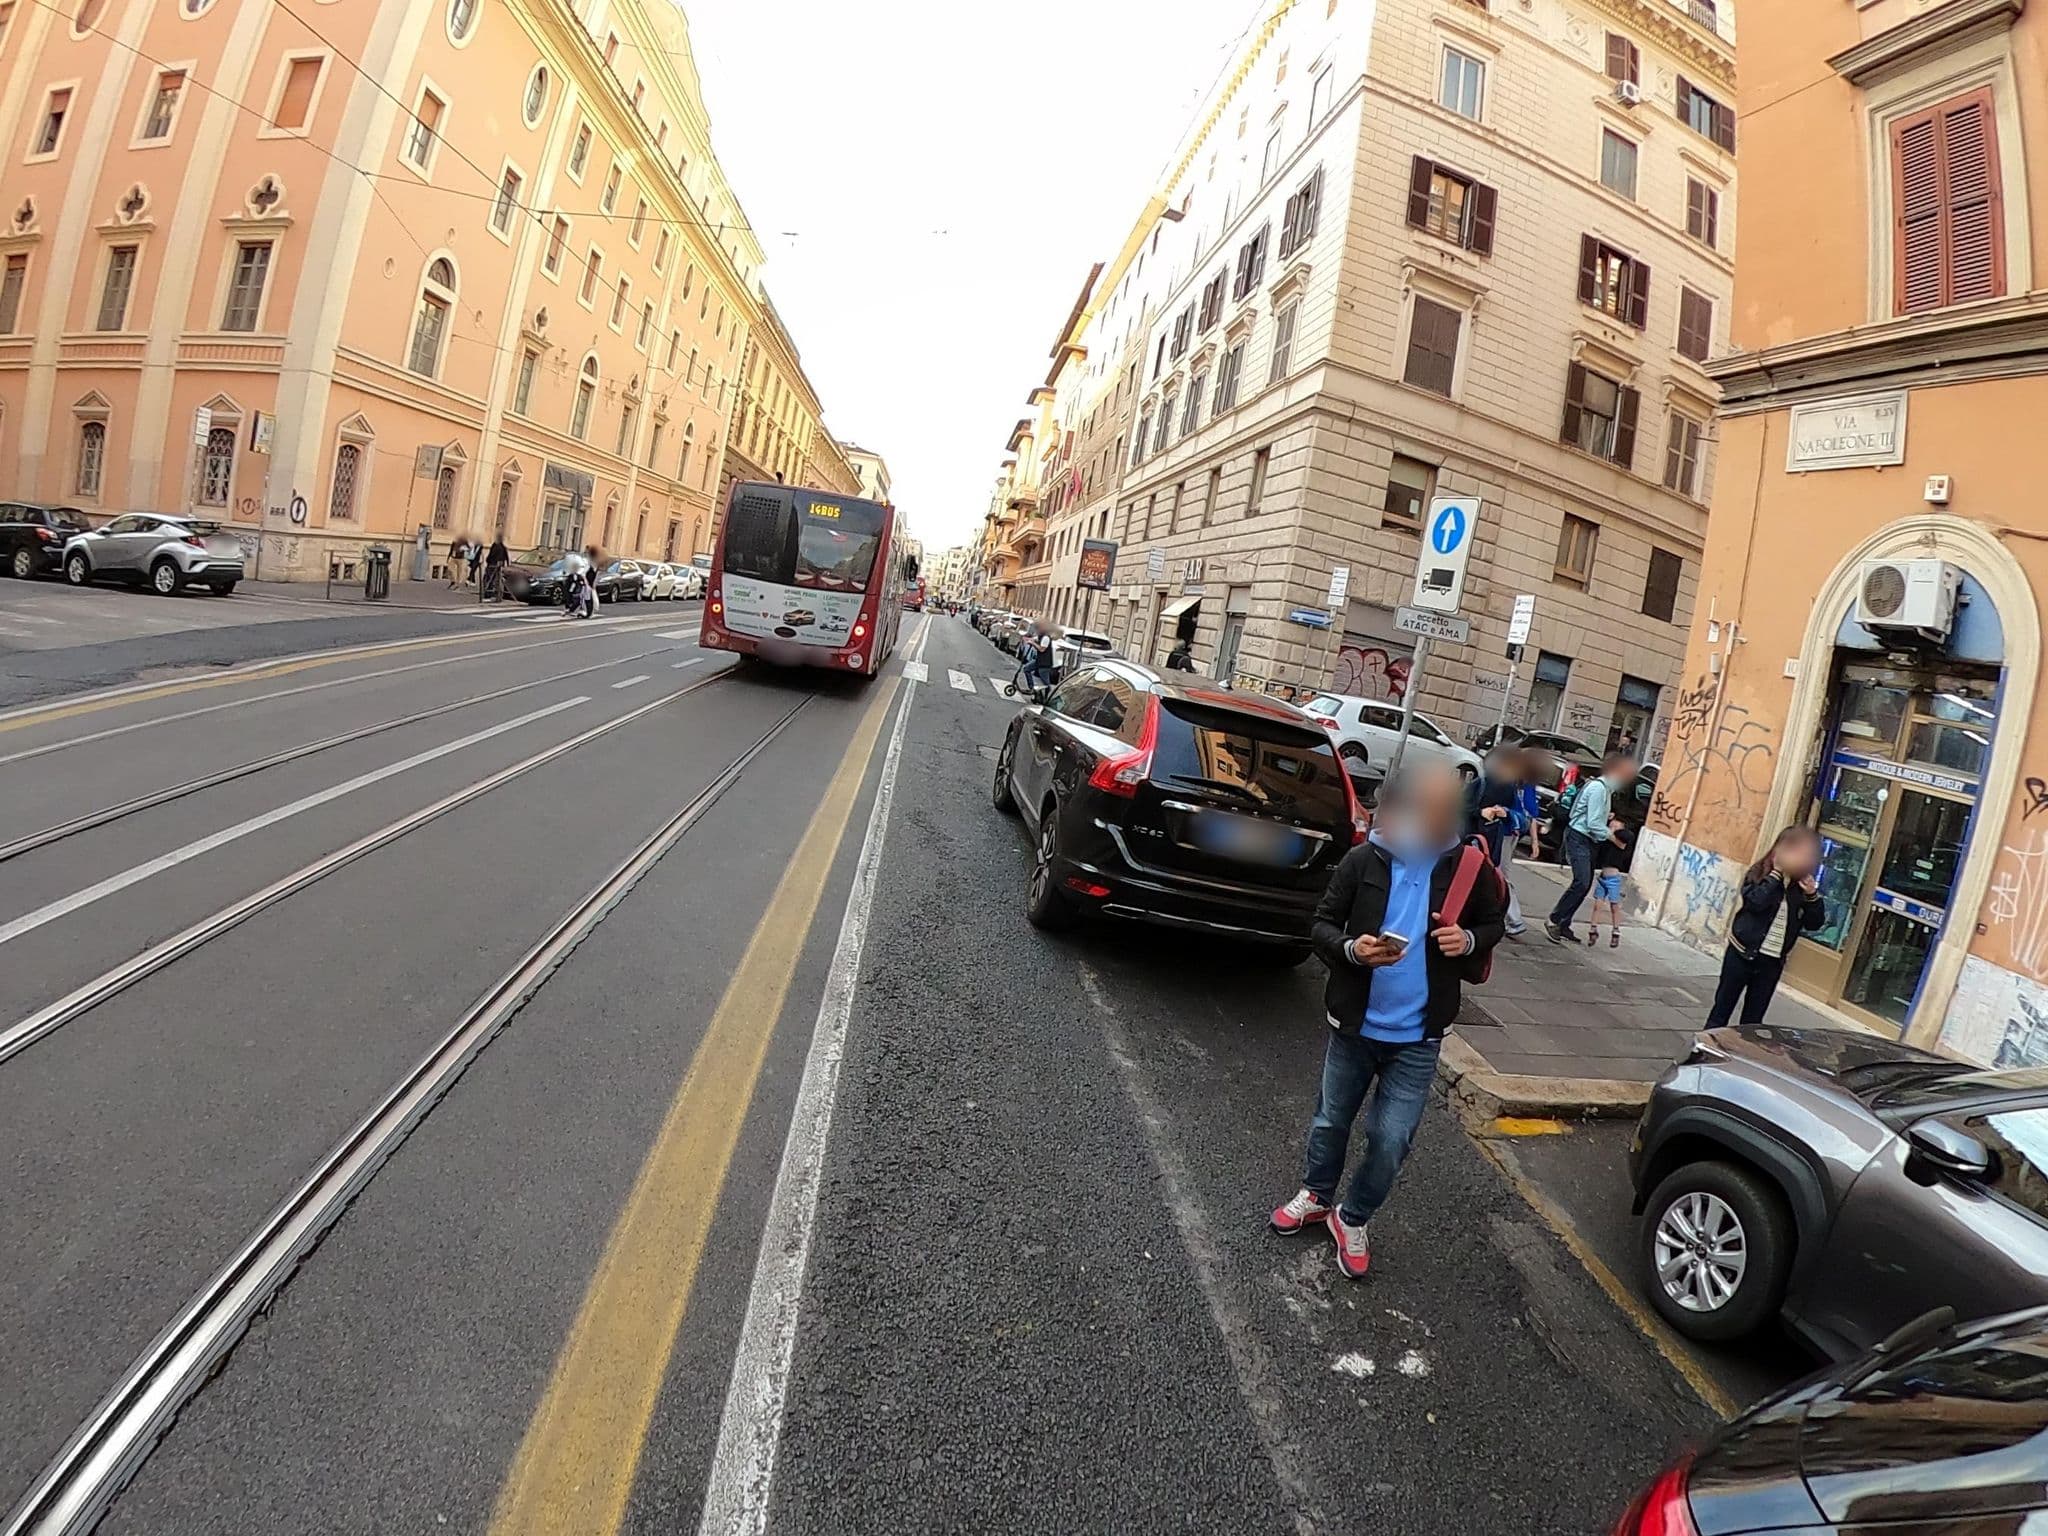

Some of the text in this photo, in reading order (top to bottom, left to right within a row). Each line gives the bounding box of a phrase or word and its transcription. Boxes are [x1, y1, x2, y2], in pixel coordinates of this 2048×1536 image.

[1834, 415, 1857, 429] VIA
[1797, 432, 1894, 453] NAPOLEONE III
[1182, 559, 1203, 580] BAR
[1402, 619, 1428, 632] ATAC
[1438, 627, 1460, 639] AMA
[1417, 614, 1449, 627] eccetto
